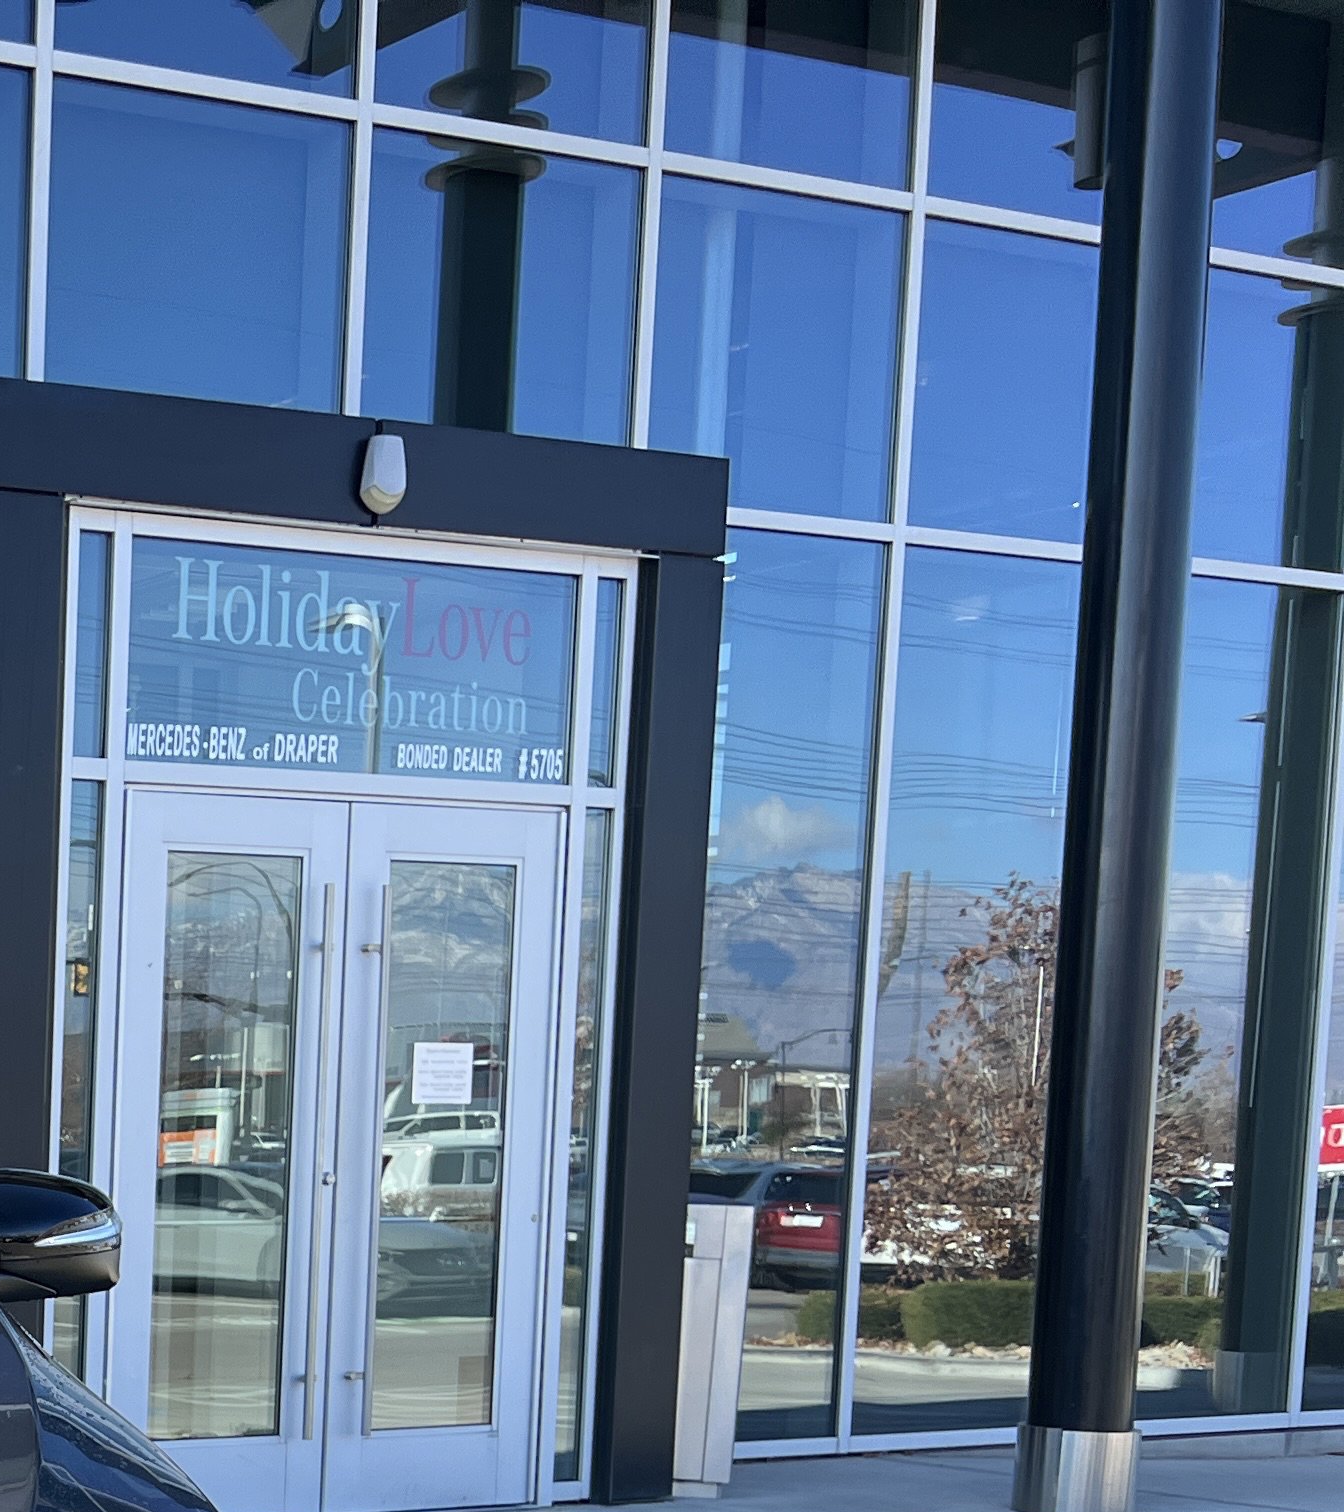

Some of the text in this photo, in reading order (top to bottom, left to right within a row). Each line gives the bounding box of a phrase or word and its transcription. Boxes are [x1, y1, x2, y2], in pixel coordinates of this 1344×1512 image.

[292, 667, 527, 735] Celebration
[252, 742, 270, 760] of
[273, 733, 339, 764] DRAPER
[397, 743, 448, 770] BONDED
[453, 747, 502, 773] DEALER
